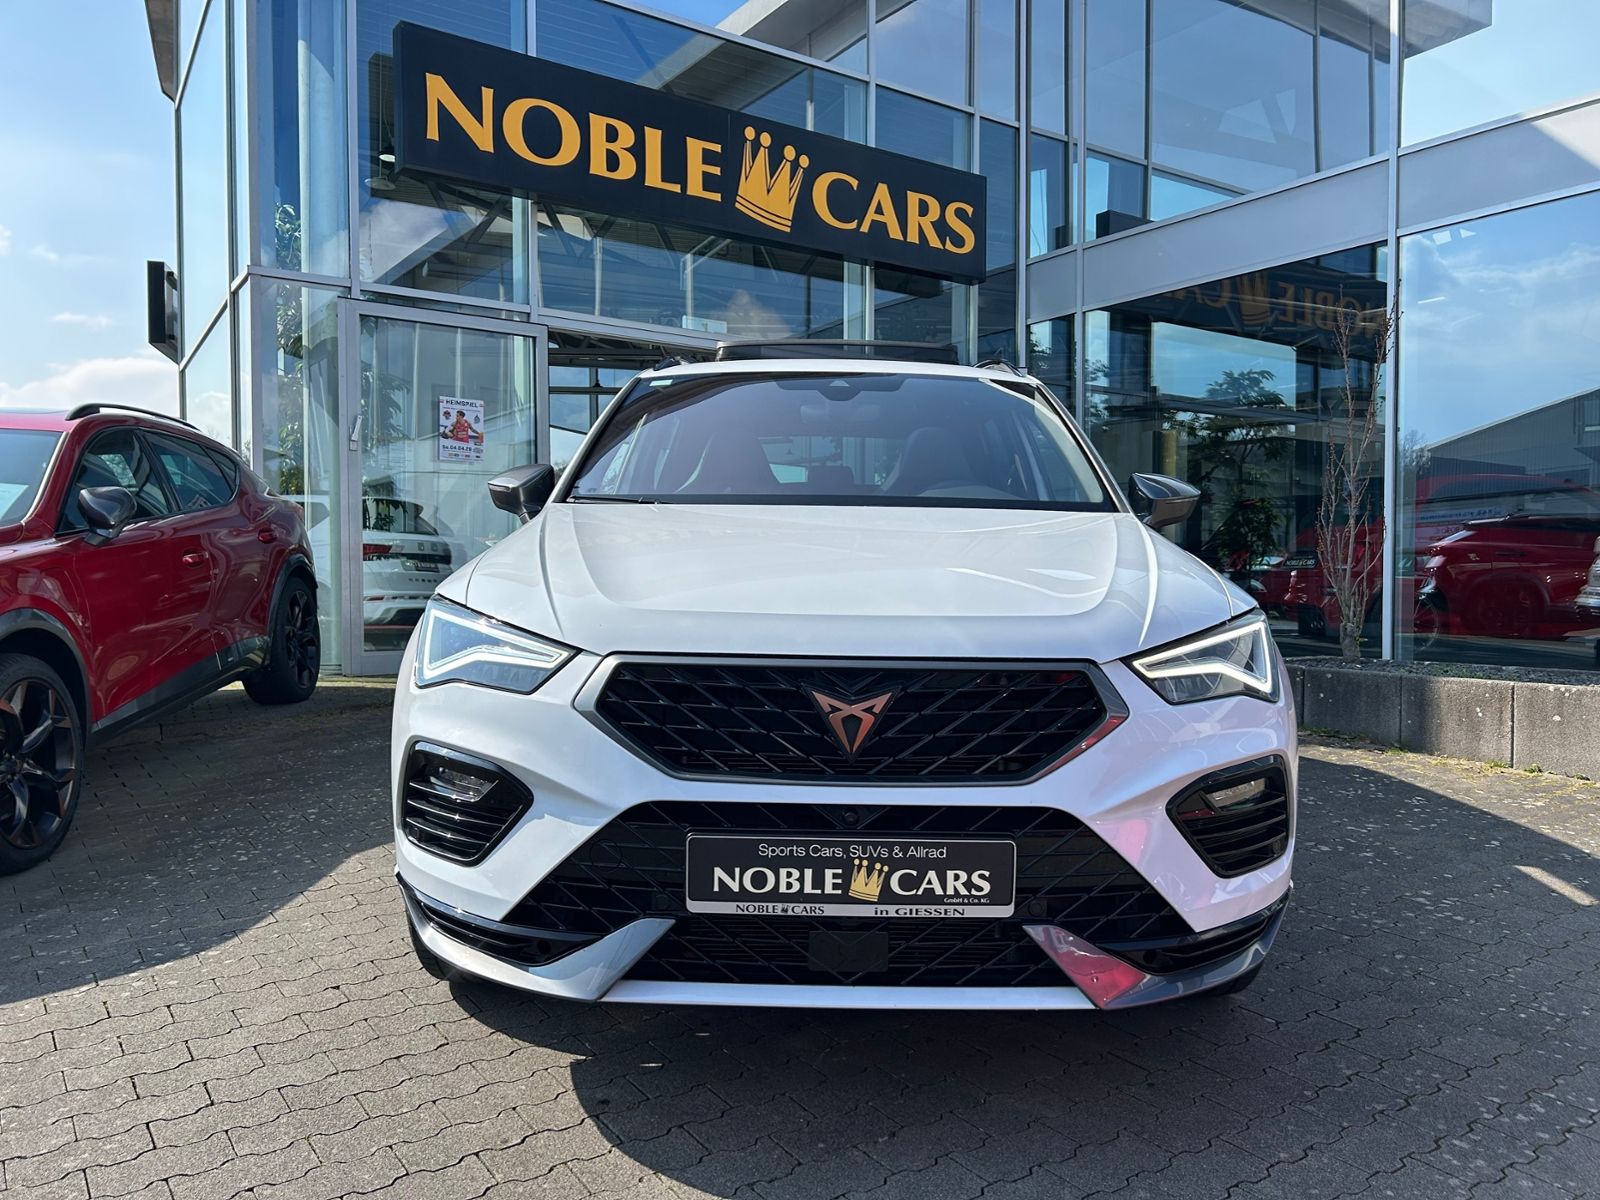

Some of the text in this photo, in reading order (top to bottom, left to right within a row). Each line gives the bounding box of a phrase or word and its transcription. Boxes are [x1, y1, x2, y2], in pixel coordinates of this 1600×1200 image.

[425, 72, 975, 255] NOBLE CARS
[445, 400, 478, 408] HEIMSPIEL
[758, 843, 947, 860] Sports Cars, SUVs & Allrad
[712, 866, 991, 896] NOBLE CARS
[735, 903, 825, 915] NOBLE CARS
[874, 906, 965, 917] in GIESSEN
